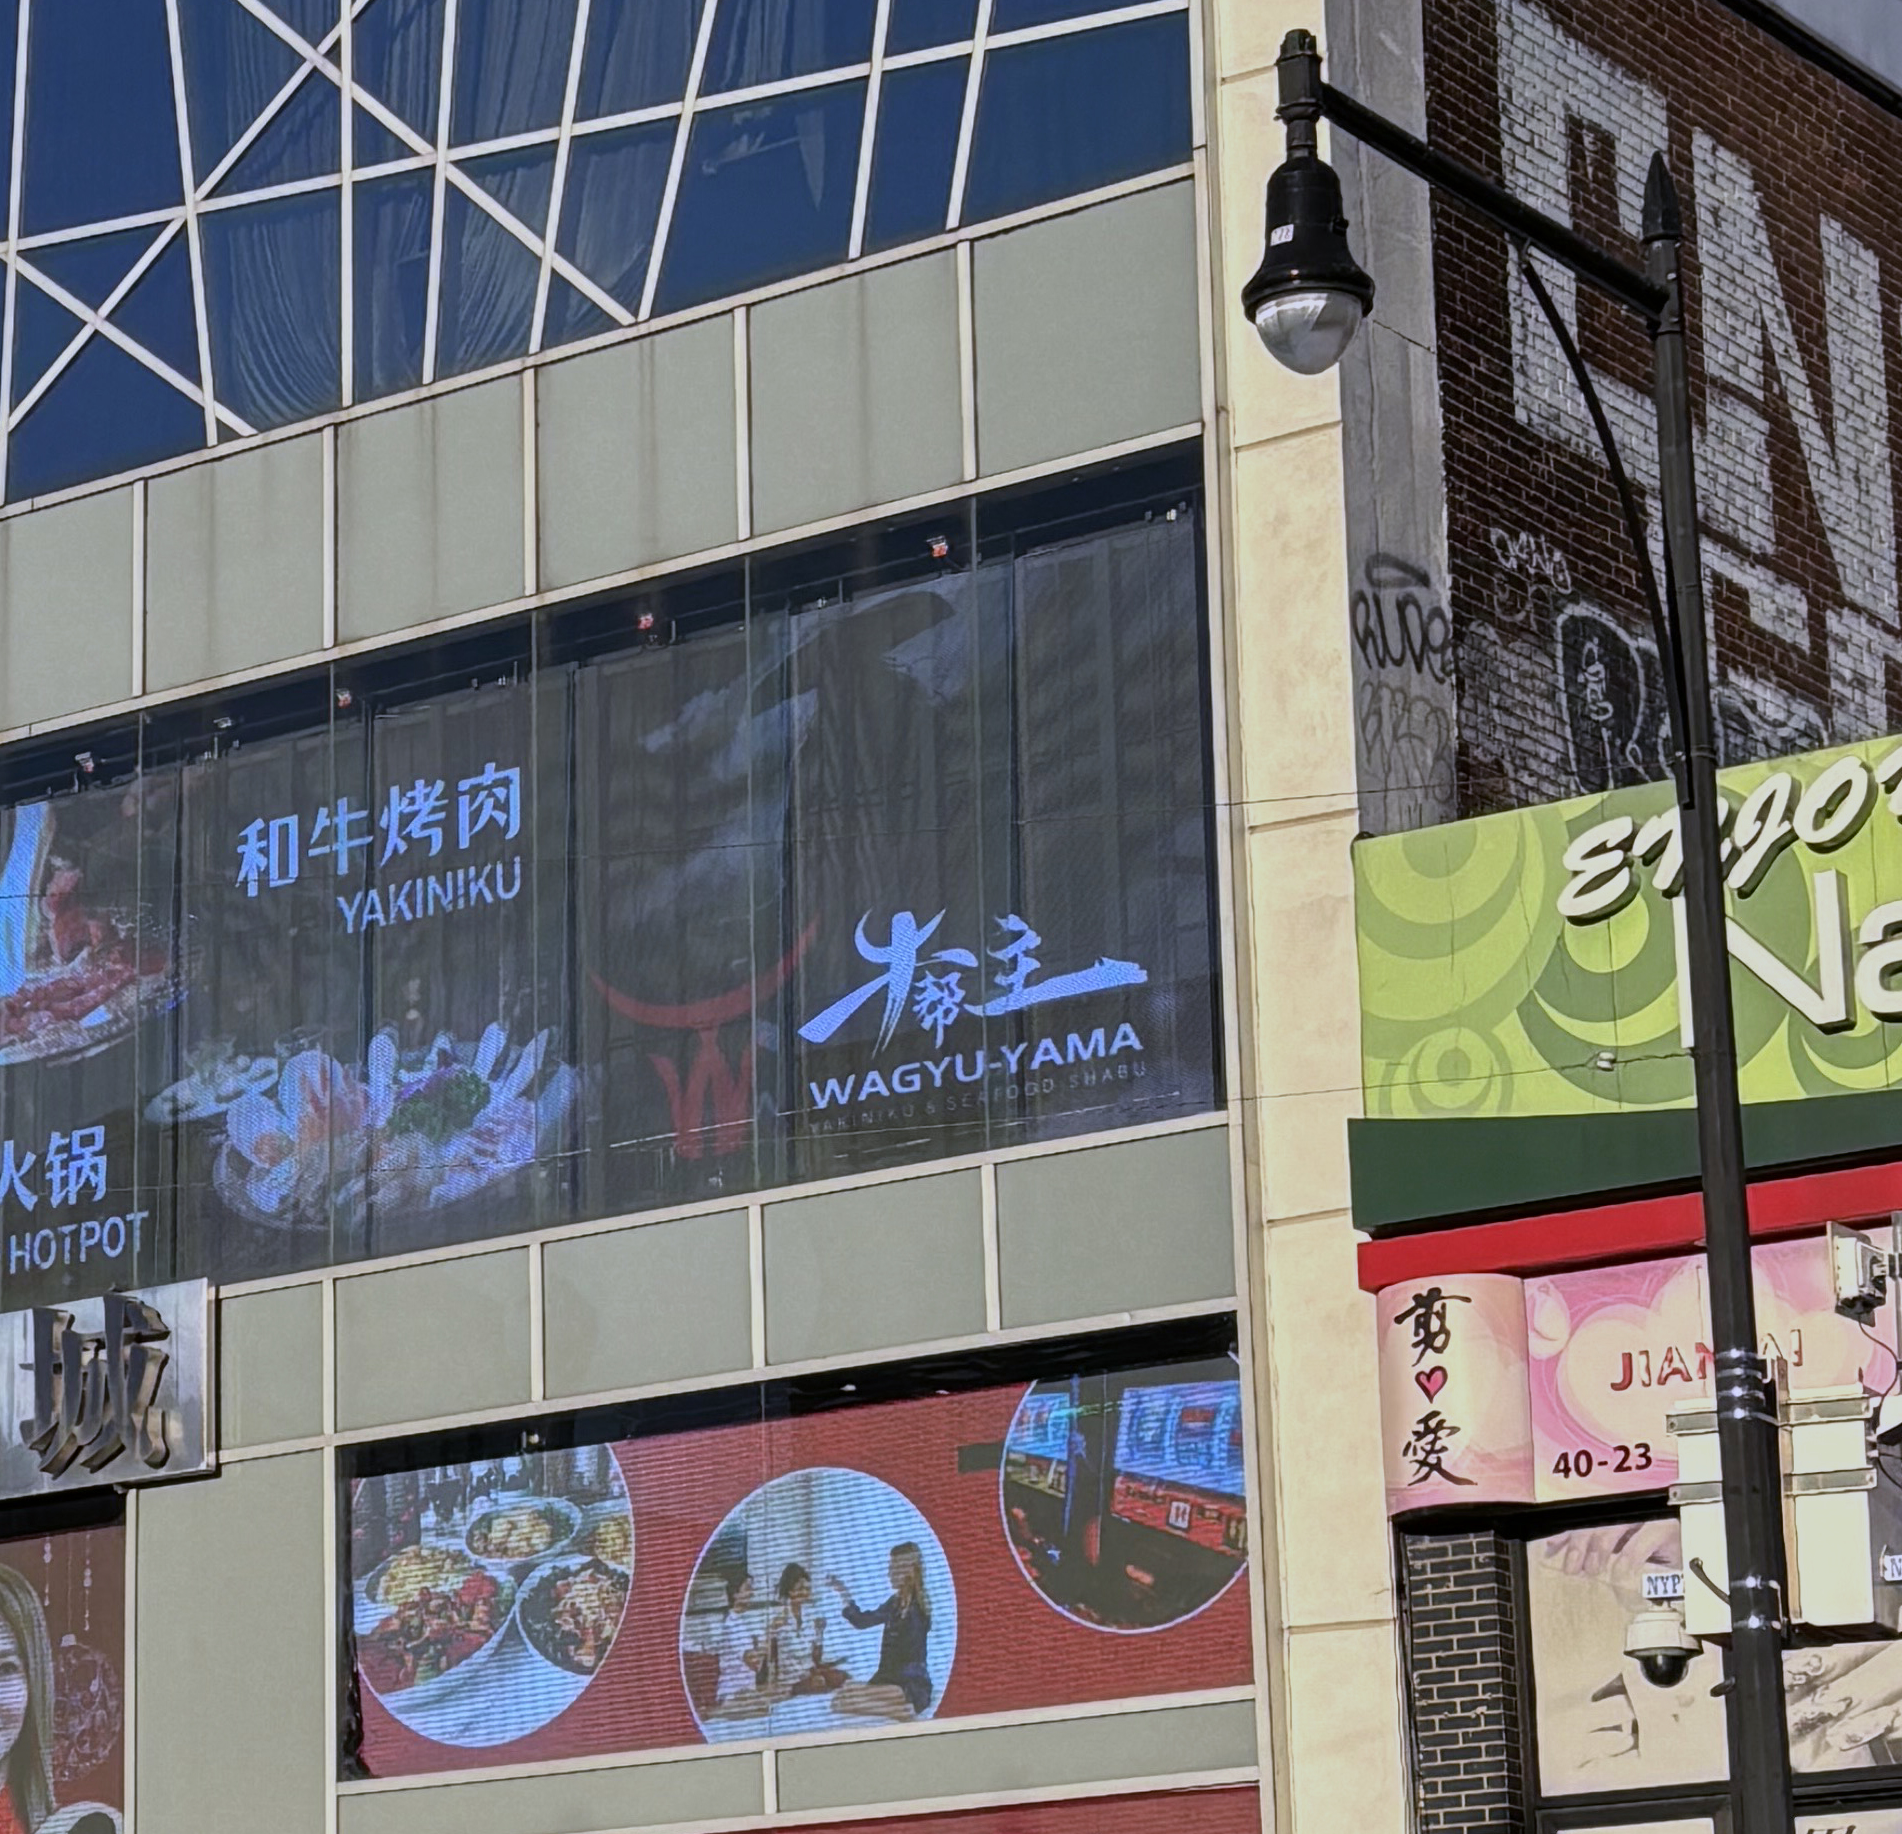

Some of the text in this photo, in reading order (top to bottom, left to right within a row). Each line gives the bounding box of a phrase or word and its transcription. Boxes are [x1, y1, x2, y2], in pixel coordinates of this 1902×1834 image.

[235, 761, 523, 898] 和牛烤肉
[336, 855, 523, 935] YAKINIKU
[808, 1021, 1145, 1110] WAGYU-YAMA
[946, 1076, 1054, 1112] SEAFOOD
[1069, 1062, 1147, 1089] SHABU
[10, 1209, 151, 1277] HOTPOT
[1402, 1409, 1478, 1488] 愛
[1552, 1443, 1654, 1479] 40-23
[1647, 1575, 1685, 1597] NYP
